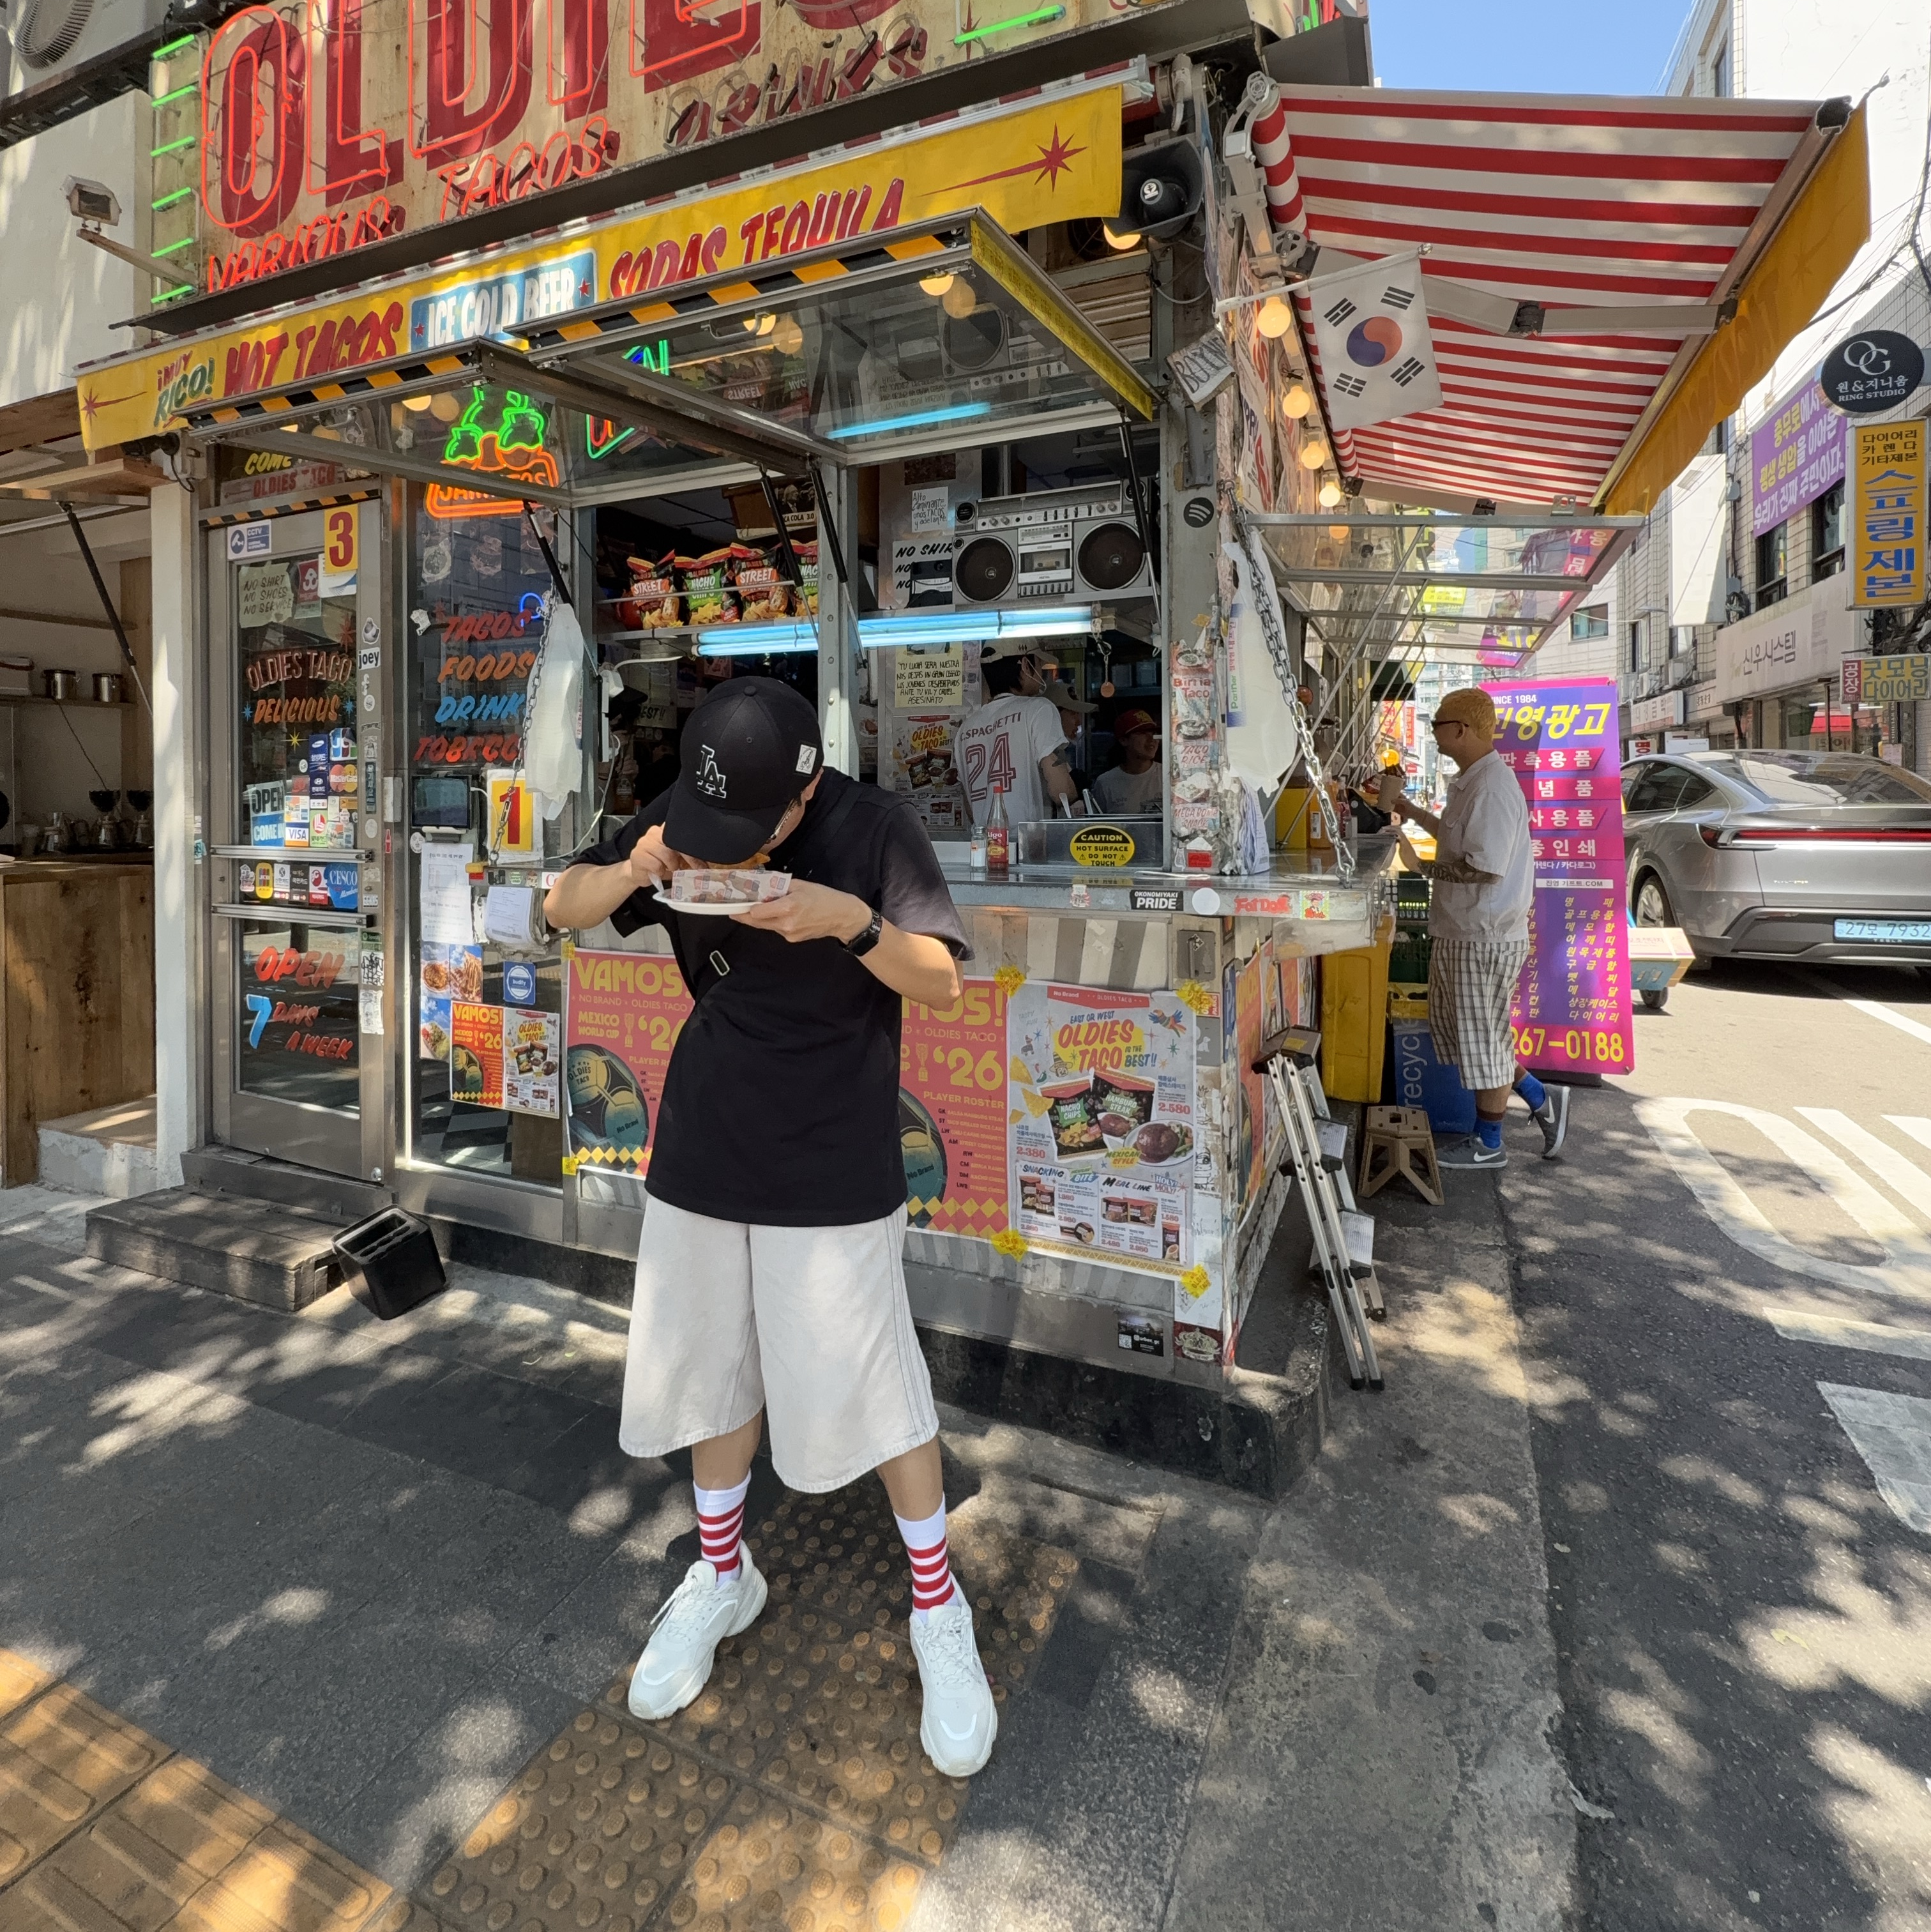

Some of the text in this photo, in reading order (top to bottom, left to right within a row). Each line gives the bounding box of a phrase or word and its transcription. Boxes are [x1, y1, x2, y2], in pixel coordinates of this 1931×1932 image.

[610, 178, 904, 298] SODAS TEQUILA
[428, 267, 575, 347] ICE COLD BEER
[225, 301, 404, 397] HOT TACOS
[1835, 374, 1909, 394] 원 & 지니움
[1838, 388, 1906, 402] RING STUDIO
[1862, 429, 1918, 443] 다이어리
[1760, 410, 1838, 493] 평생 생업을 이어온
[1861, 441, 1918, 455] 카렌다
[1861, 452, 1918, 466] 기타제본
[252, 472, 297, 498] OLDIES
[1754, 491, 1778, 529] 우리가
[1780, 476, 1798, 514] 진짜
[927, 507, 945, 517] TACOS
[247, 527, 263, 537] CCTV
[1861, 469, 1918, 599] 스프링제본
[329, 512, 354, 567] 3
[895, 546, 916, 558] NO
[739, 568, 773, 584] STREET
[895, 564, 911, 574] NO
[243, 575, 285, 591] NO SHIRT
[633, 581, 663, 595] STREET
[691, 575, 716, 588] NACHO
[243, 588, 287, 602] NO SHOES
[243, 605, 256, 615] NO
[442, 608, 533, 643] TACOS
[358, 650, 380, 670] joey
[1743, 630, 1797, 676] 신우시스템
[246, 651, 352, 691] OLDIES TACO
[437, 649, 536, 683] FOODS
[1173, 677, 1211, 688] Birria
[1844, 660, 1859, 694] 공장
[1183, 688, 1210, 699] Taco
[1863, 678, 1930, 701] 다이어리
[907, 696, 943, 704] ASESINATO
[1515, 694, 1537, 703] 1984
[254, 694, 341, 724] DELICIOUS
[1493, 703, 1611, 741] 진영광고
[912, 726, 944, 742] OLDIES
[921, 738, 939, 751] TACO
[1181, 745, 1208, 754] TACO
[1181, 756, 1208, 764] RICE
[696, 744, 727, 798] LA
[965, 732, 1017, 803] 24
[254, 786, 284, 814] OPEN
[500, 786, 520, 844] 1
[1173, 809, 1195, 818] MEGA
[254, 823, 277, 841] COME
[289, 829, 307, 840] VISA
[329, 870, 358, 886] CESCO
[1136, 897, 1177, 910] PRIDE
[1564, 909, 1614, 920] 골프용품
[1564, 922, 1615, 933] 메모함
[1845, 922, 1930, 938] 27모 7932
[1566, 934, 1616, 945] 어깨띠
[1566, 947, 1616, 959] 원목제품
[255, 945, 345, 989] OPEN
[1566, 959, 1617, 971] 구급함
[1568, 984, 1618, 997] 메달
[579, 994, 688, 1012] NO BRAND OLDIES TACO
[1568, 997, 1618, 1009] 상장케이스
[246, 994, 321, 1049] 7 DAYS
[453, 1004, 503, 1025] VAMOS!
[578, 1010, 619, 1027] MEXICO
[1070, 1010, 1115, 1023] EAST OR WEST
[1569, 1010, 1619, 1023] 다이어리
[519, 1023, 543, 1033] OLDIES
[578, 1026, 619, 1039] WORLD CUP
[1058, 1019, 1134, 1049] OLDIES
[525, 1032, 539, 1042] TACO
[924, 1028, 997, 1043] OLDIES TACO
[285, 1030, 354, 1060] A WEEK
[629, 1056, 660, 1065] PLAYER
[1079, 1046, 1123, 1074] TACO
[1125, 1053, 1157, 1068] BEST!!
[568, 1066, 591, 1081] OLDIES
[576, 1076, 589, 1086] TACO
[923, 1091, 1005, 1110] PLAYER ROSTER
[1060, 1102, 1081, 1113] NACHO
[1063, 1110, 1081, 1120] CHIPS
[1110, 1103, 1131, 1114] STEAK
[1022, 1164, 1064, 1178] SNACKING
[1103, 1176, 1130, 1188] MEAL
[1132, 1183, 1152, 1192] LINE
[1155, 1175, 1179, 1187] HOLY!
[1155, 1183, 1176, 1195] MOLY!
